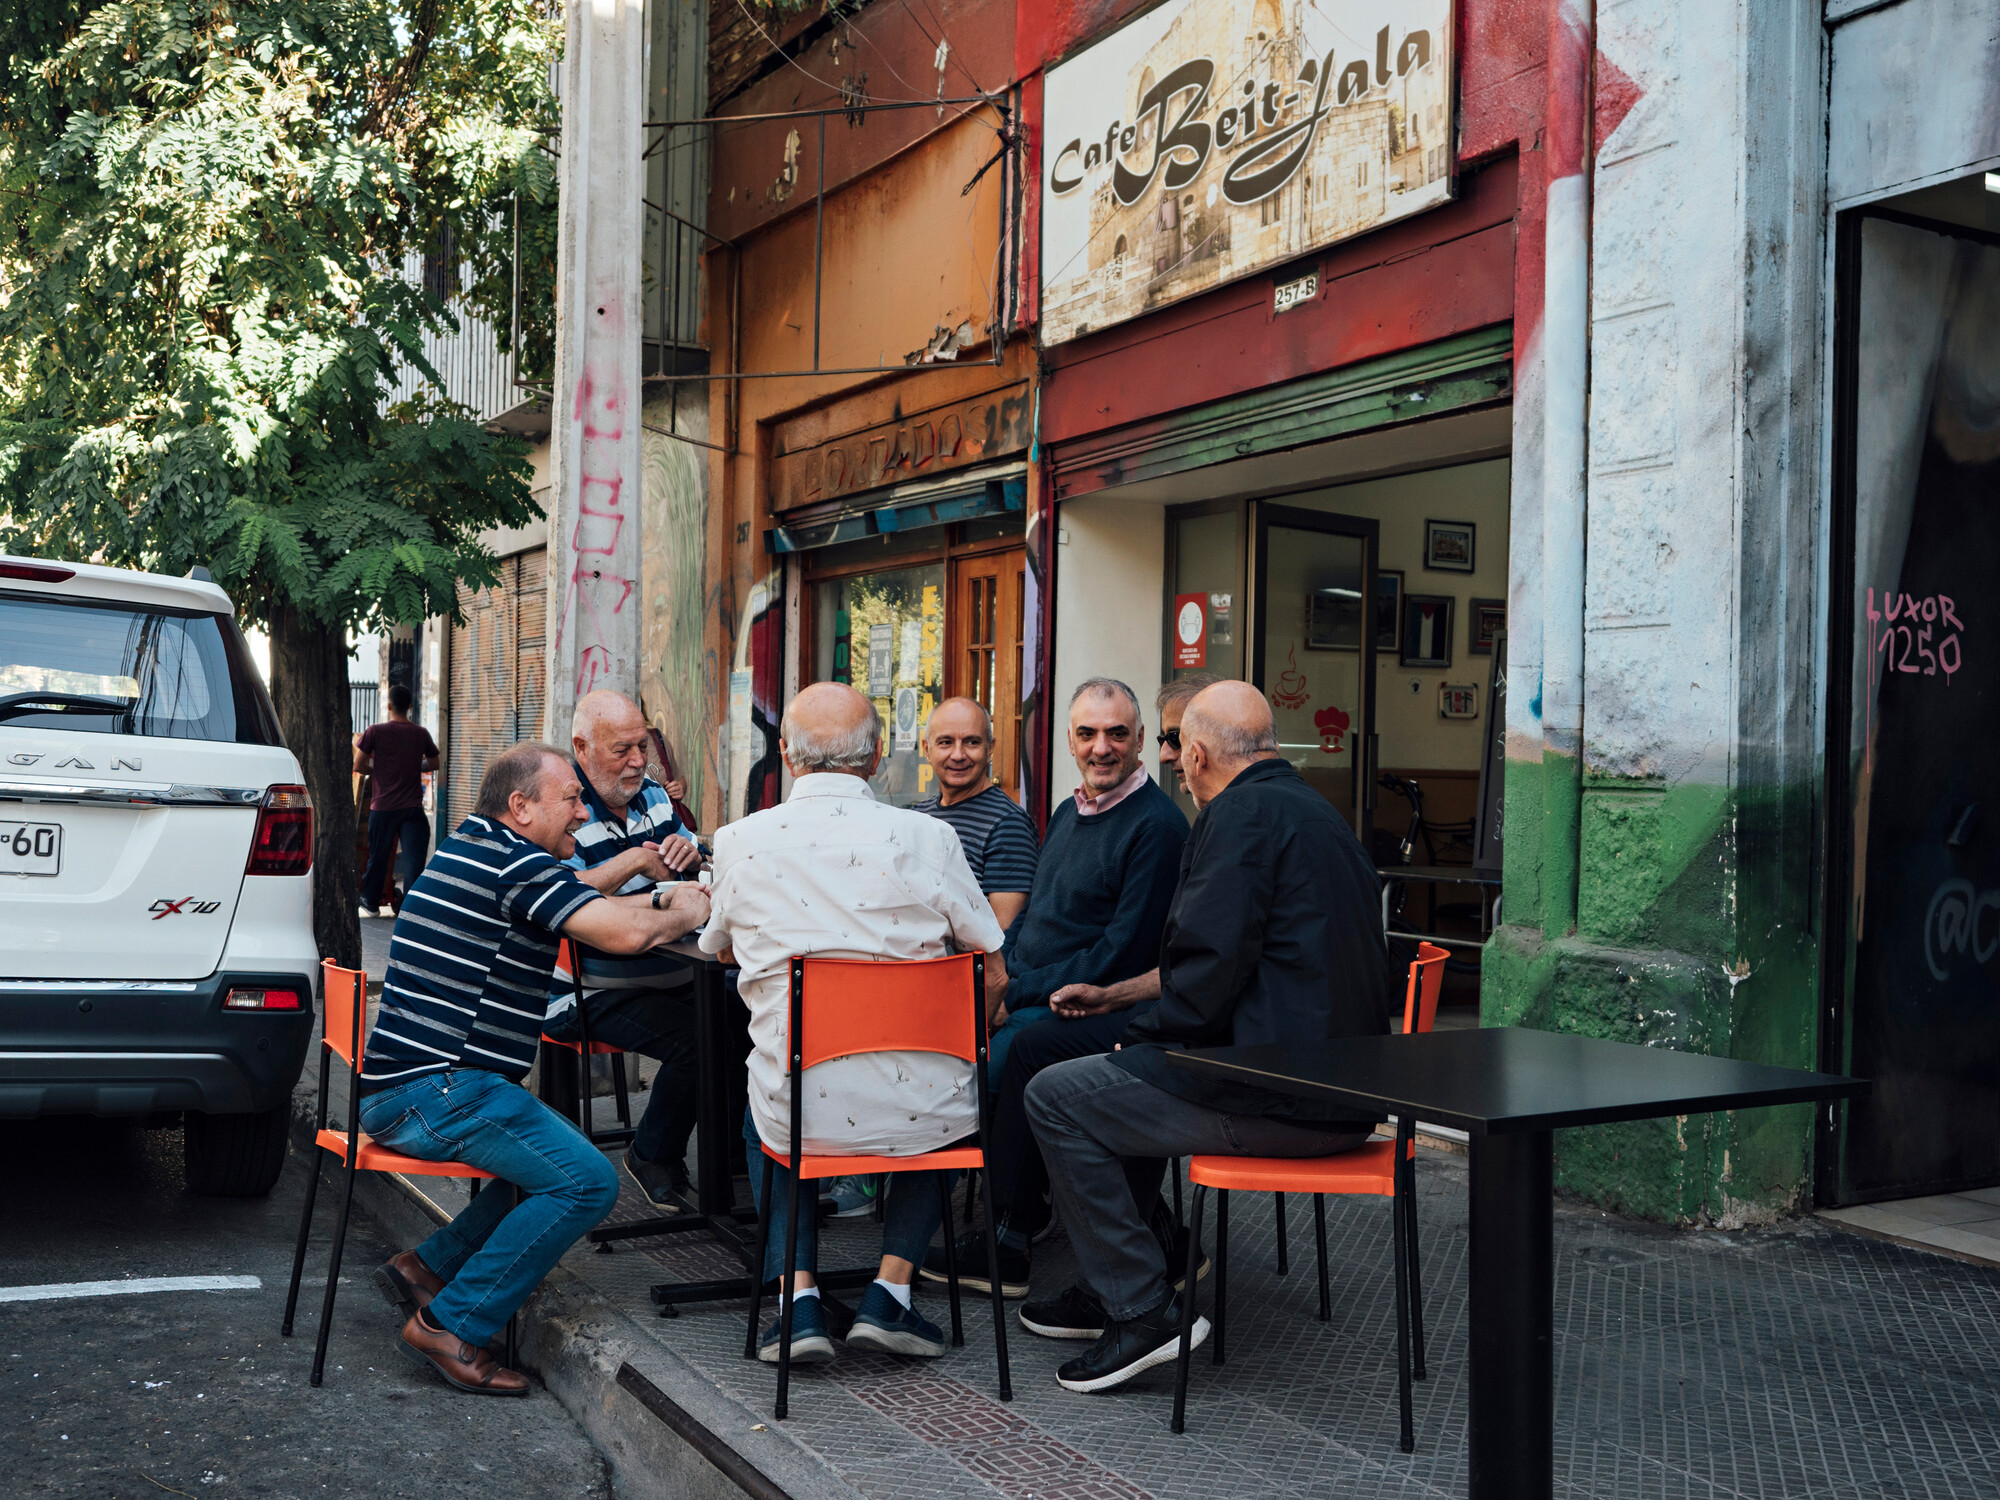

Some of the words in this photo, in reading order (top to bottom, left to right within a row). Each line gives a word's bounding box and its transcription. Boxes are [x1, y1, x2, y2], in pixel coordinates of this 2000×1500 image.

[1051, 120, 1136, 195] Cafe
[1276, 279, 1315, 305] 257-B
[1866, 587, 1964, 632] LUXOR
[1878, 623, 1962, 676] 1250
[6, 752, 143, 772] GAN
[148, 896, 222, 921] CX70
